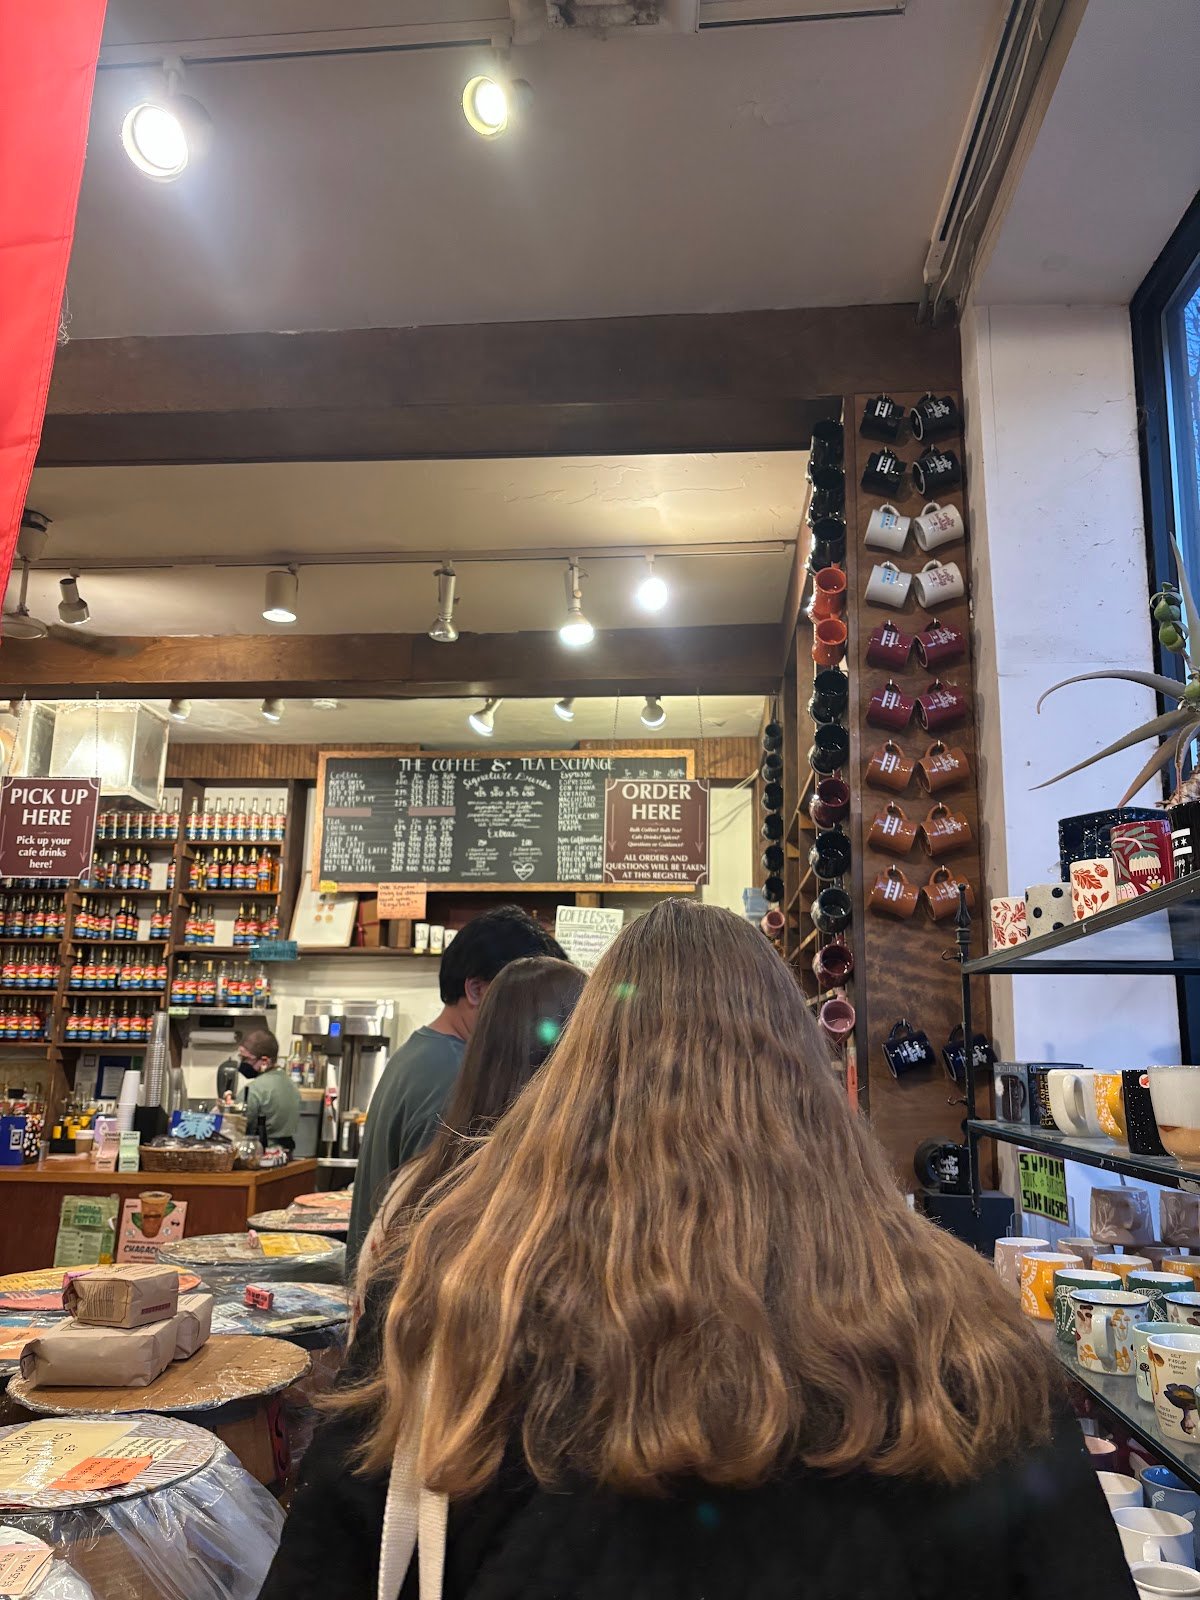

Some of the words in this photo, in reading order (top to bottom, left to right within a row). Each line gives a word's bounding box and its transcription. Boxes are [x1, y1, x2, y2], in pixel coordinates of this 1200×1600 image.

[399, 758, 426, 772] THE
[431, 758, 480, 772] COFFEE
[520, 758, 545, 771] TEA
[550, 758, 616, 772] EXCHANGE
[10, 788, 55, 805] PICK
[60, 789, 88, 805] UP
[622, 784, 692, 800] ORDER
[22, 809, 72, 826] HERE
[632, 804, 681, 820] HERE
[16, 836, 35, 845] Pick
[37, 838, 48, 847] up
[51, 838, 72, 847] your
[18, 848, 37, 856] cafe
[39, 848, 66, 857] drinks
[29, 860, 52, 868] here!
[559, 908, 604, 923] COFFEES
[1020, 1154, 1064, 1179] SUPPORT
[1023, 1190, 1042, 1211] SIDE
